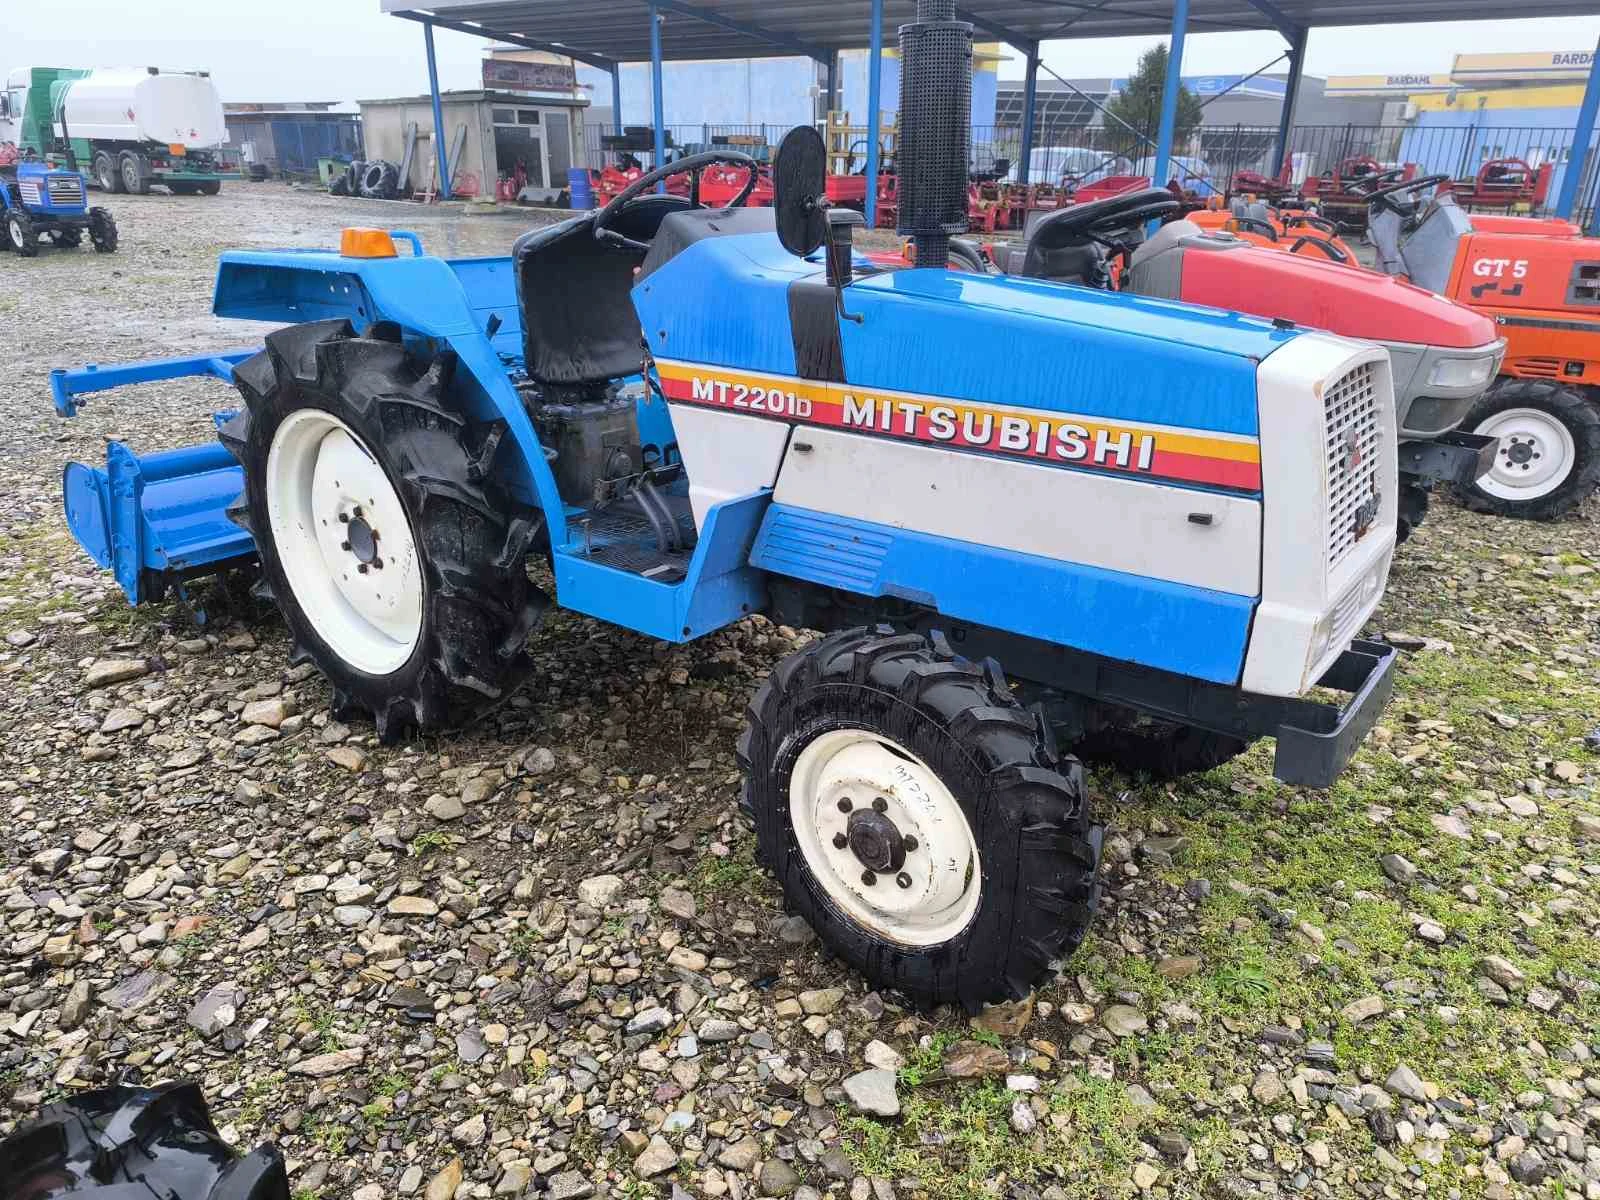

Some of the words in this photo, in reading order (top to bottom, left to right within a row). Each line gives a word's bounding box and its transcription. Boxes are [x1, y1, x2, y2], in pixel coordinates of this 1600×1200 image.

[1472, 258, 1511, 277] GT
[1512, 260, 1529, 279] 5
[692, 377, 813, 418] MT2201D
[842, 395, 1156, 470] MITSUBISHI
